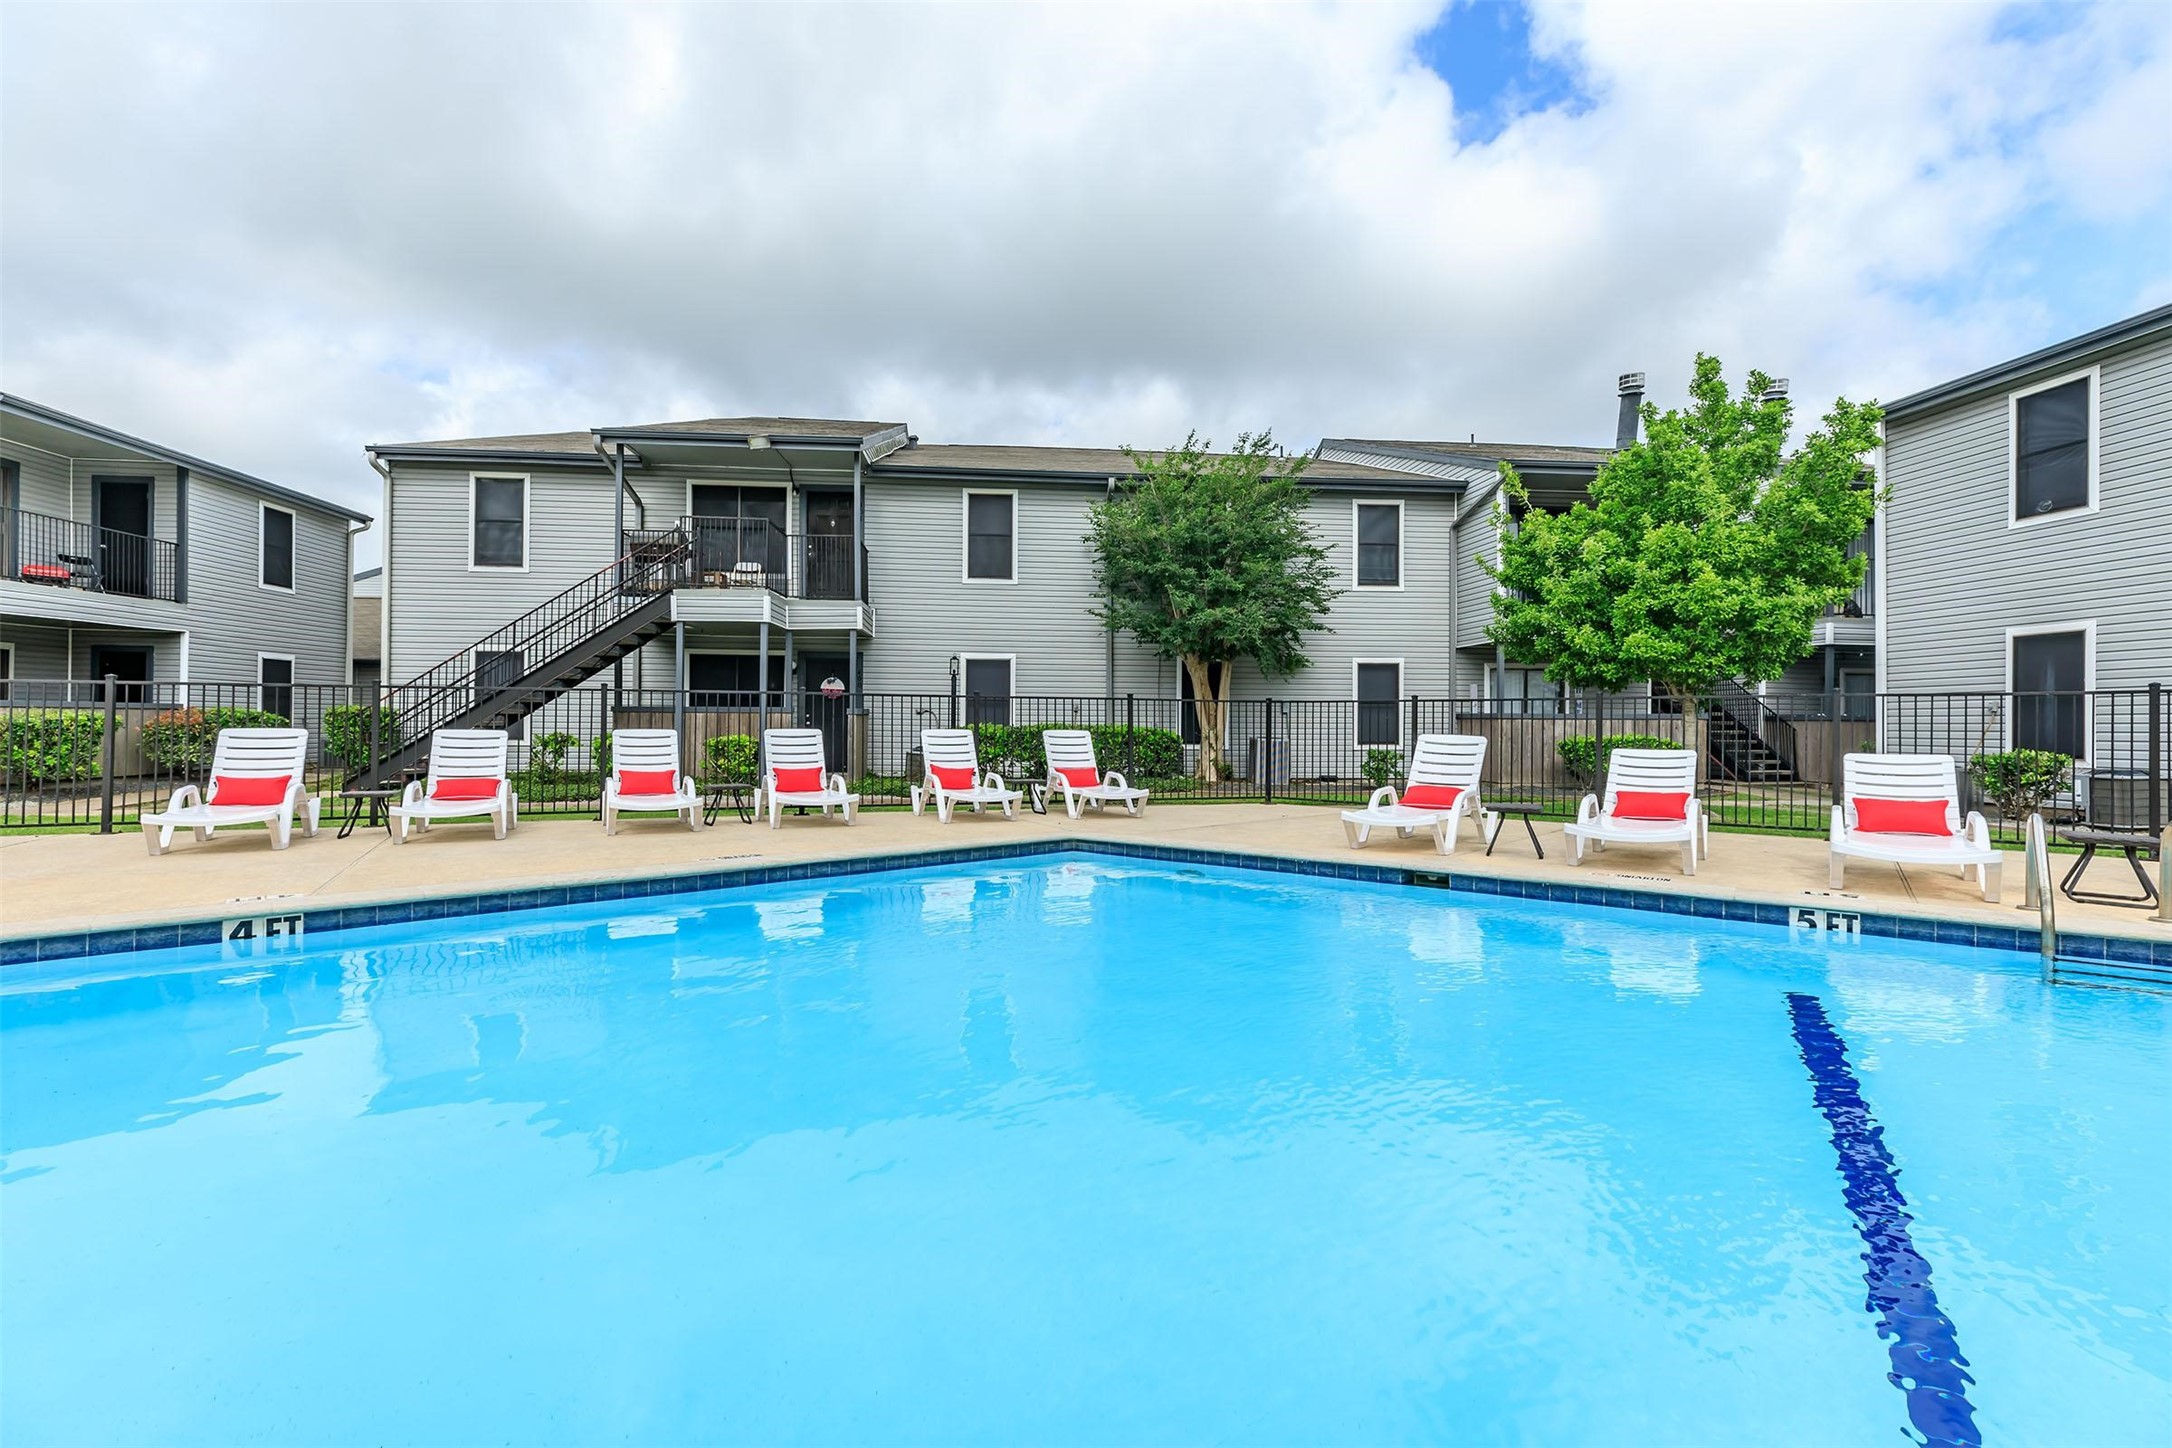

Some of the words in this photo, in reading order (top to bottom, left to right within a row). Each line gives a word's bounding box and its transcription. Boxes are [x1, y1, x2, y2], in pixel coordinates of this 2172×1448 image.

[228, 920, 257, 940] 4
[266, 915, 302, 937] FT
[1797, 909, 1817, 928] 5
[1826, 912, 1859, 933] FT
